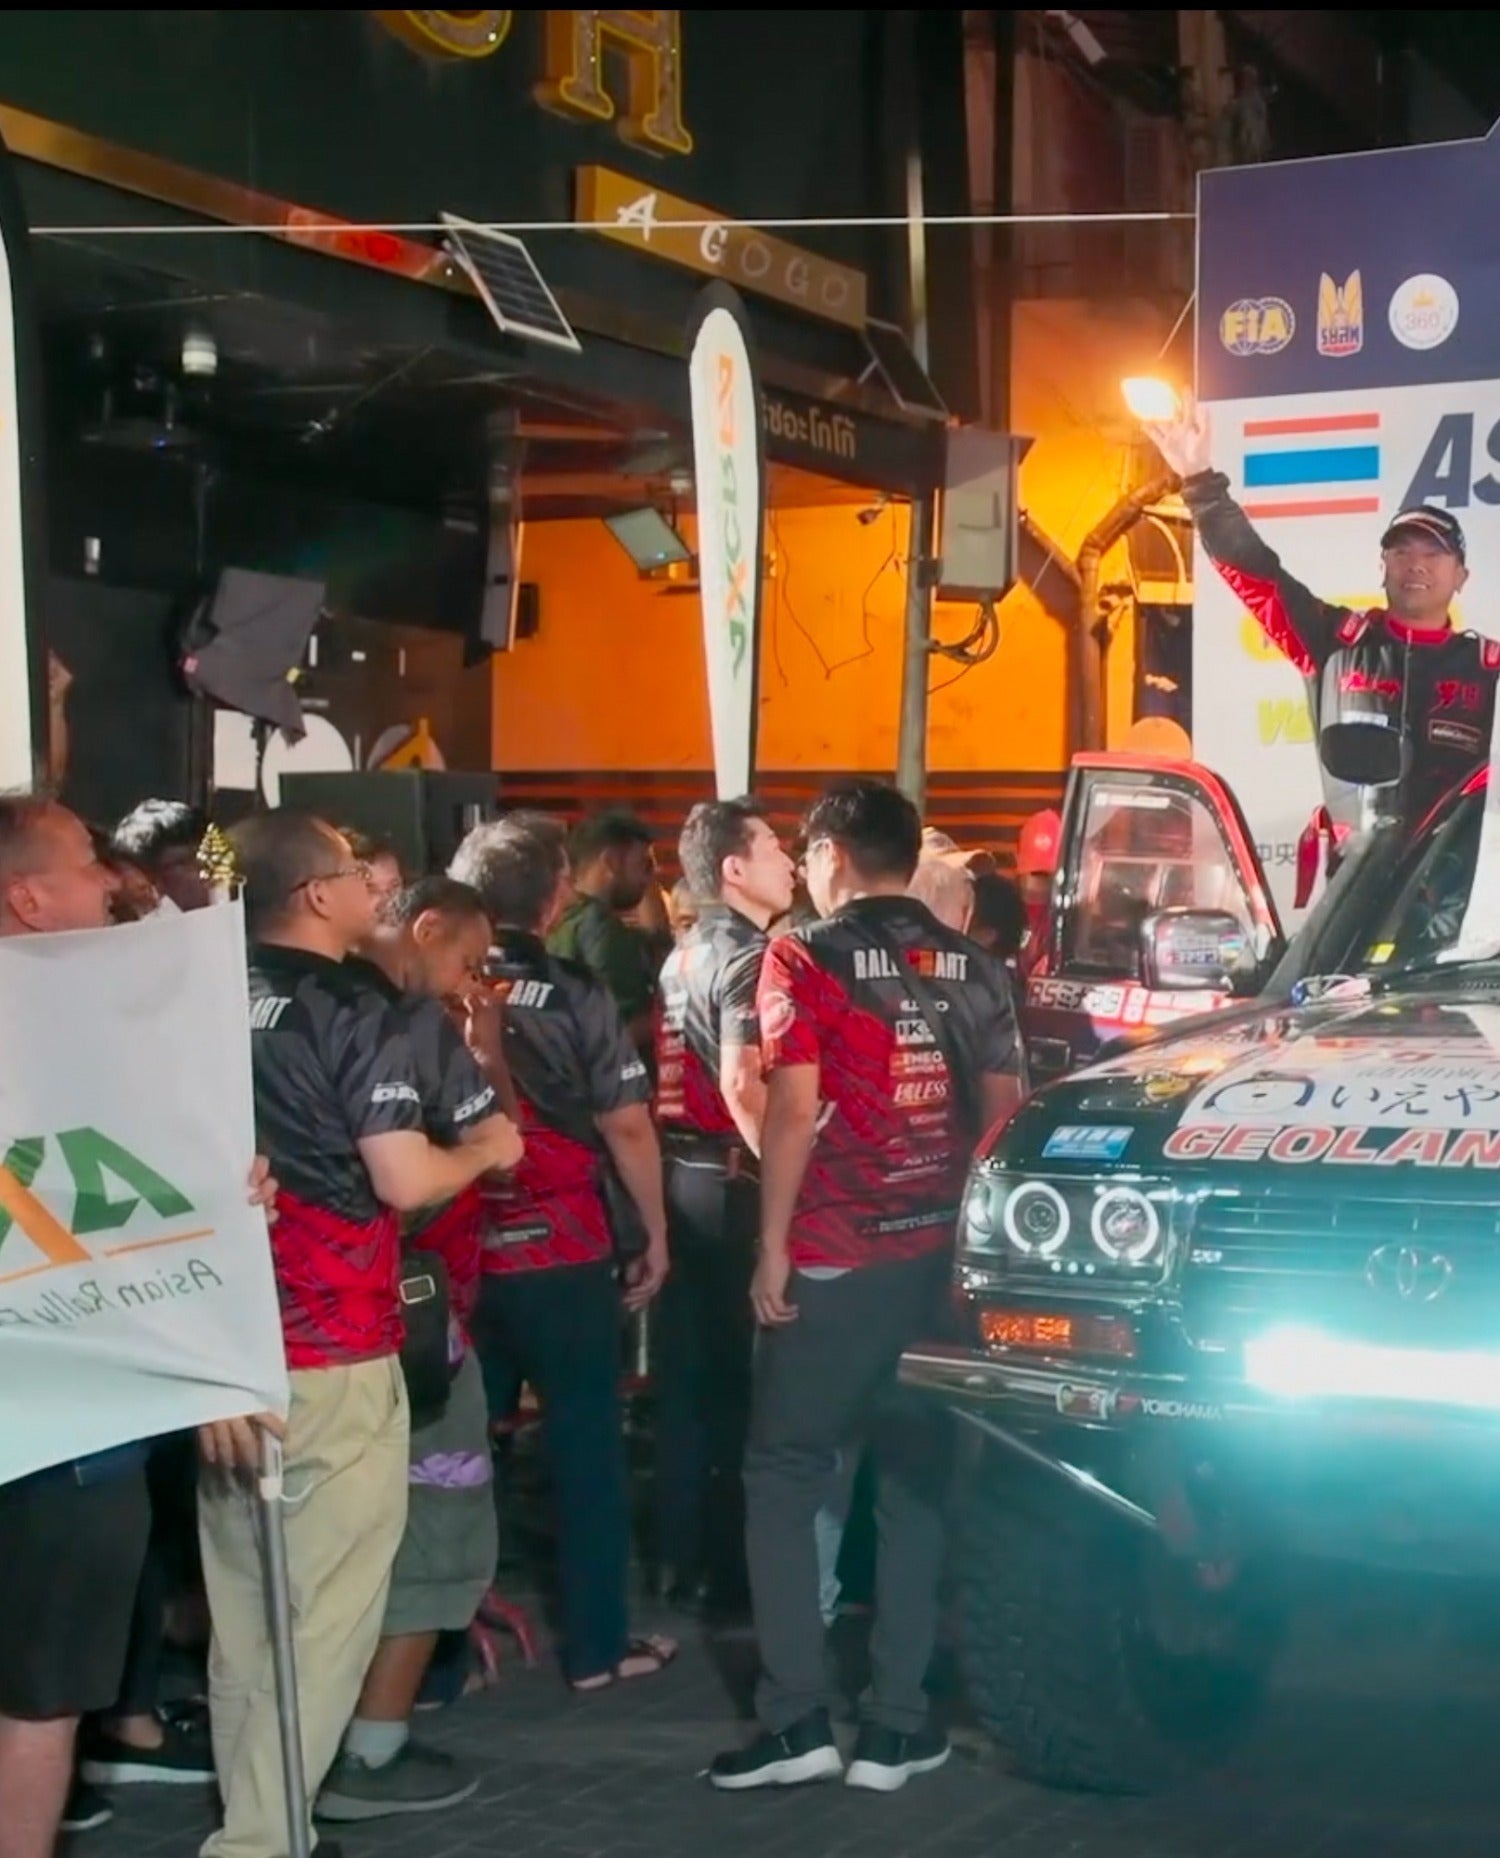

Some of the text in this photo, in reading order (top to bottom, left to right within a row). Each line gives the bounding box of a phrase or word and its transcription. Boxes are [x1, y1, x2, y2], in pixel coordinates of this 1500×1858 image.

[616, 192, 658, 242] A
[1223, 308, 1287, 345] FIA
[1140, 1397, 1222, 1421] YOKOHAMA
